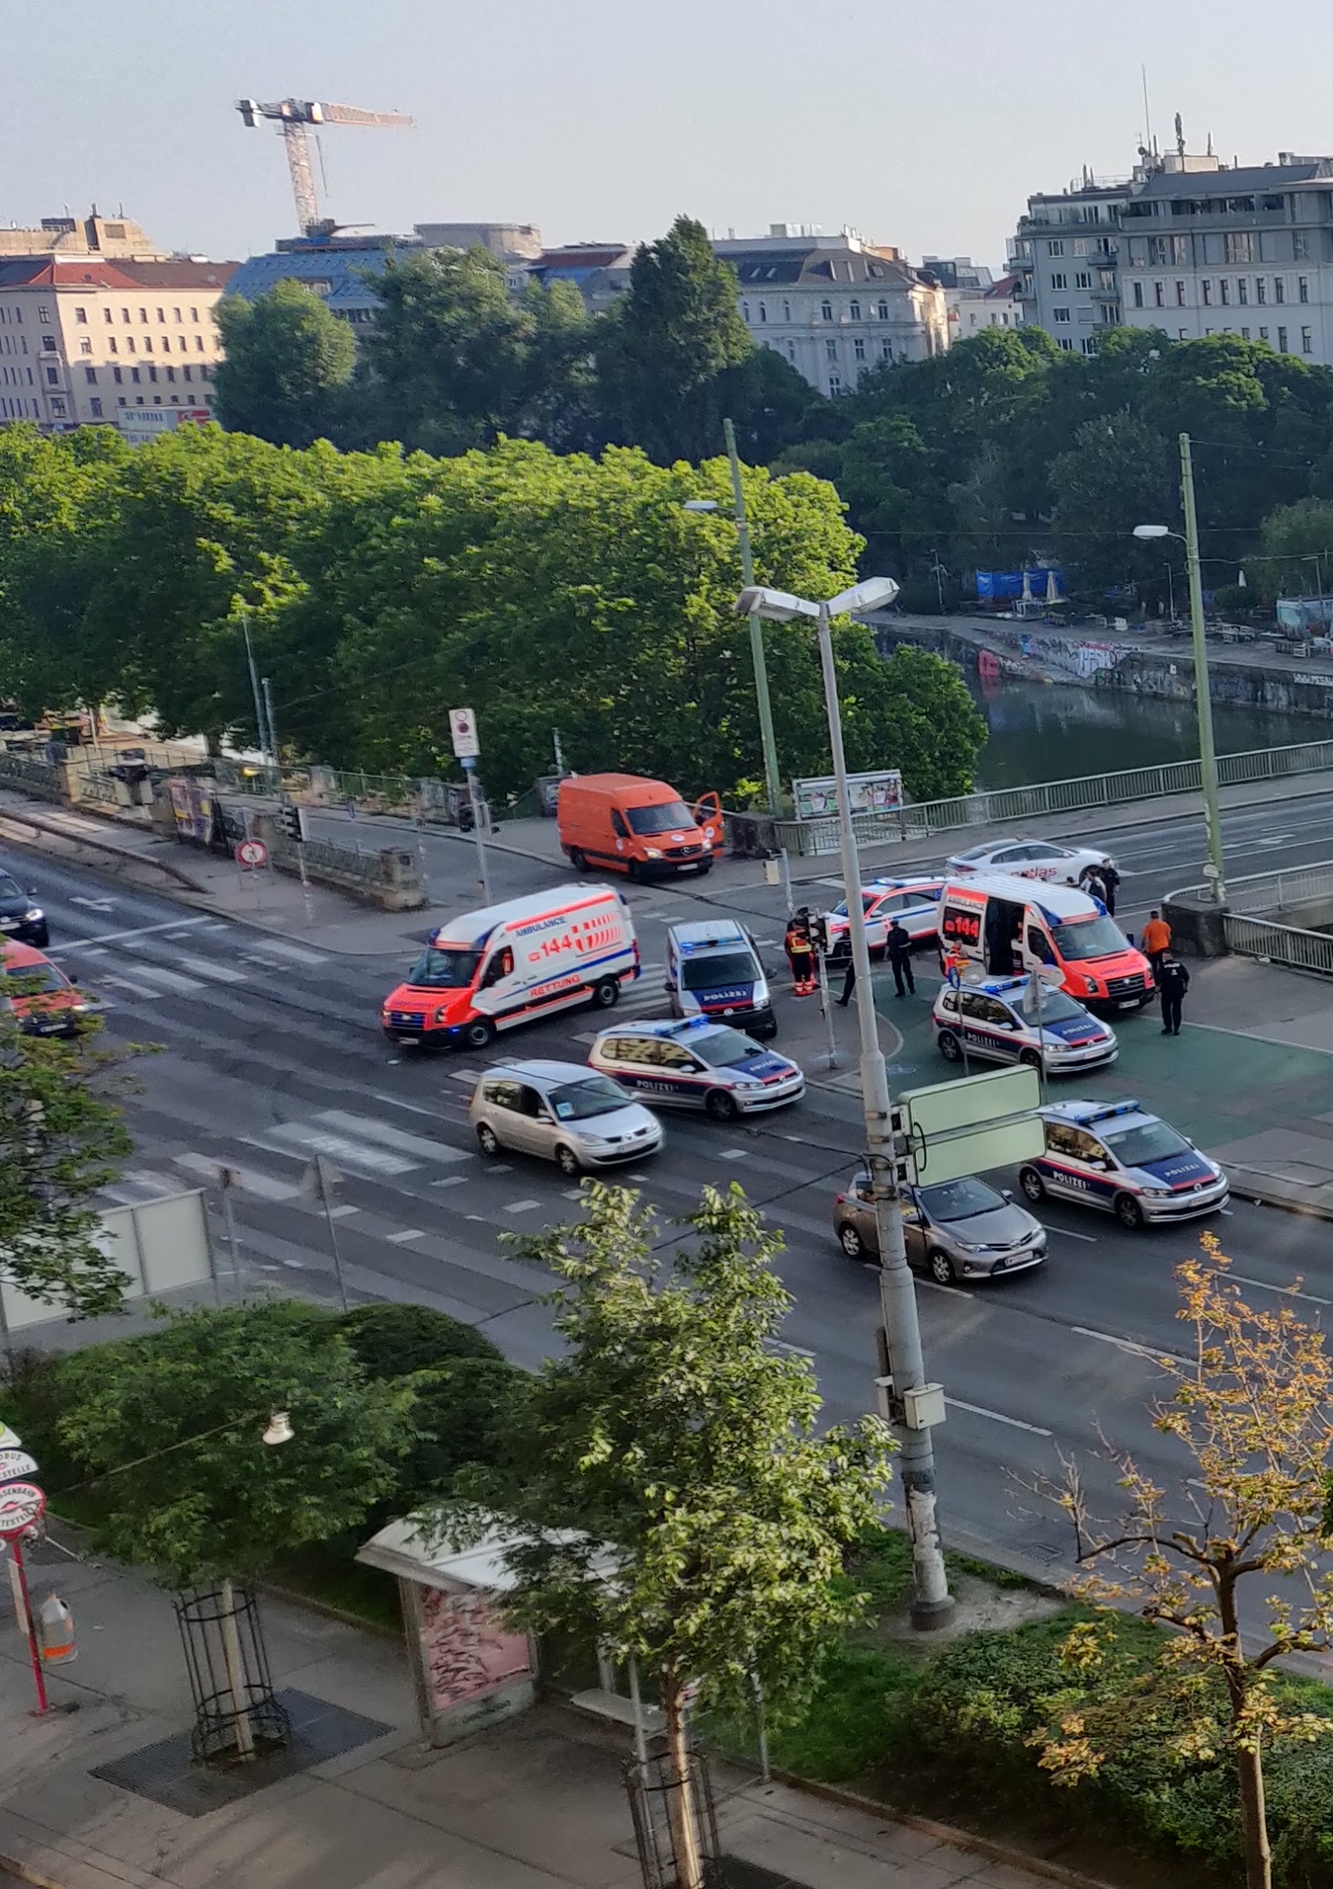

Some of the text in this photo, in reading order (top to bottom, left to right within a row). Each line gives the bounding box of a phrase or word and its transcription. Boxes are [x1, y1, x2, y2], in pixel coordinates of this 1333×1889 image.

[515, 916, 567, 938] AMBULANCE
[955, 917, 979, 938] 144
[540, 934, 572, 957] 144
[529, 974, 580, 998] RETTUNG
[703, 990, 747, 1001] POLIZEI
[967, 1031, 996, 1048] POLIZEI
[636, 1079, 674, 1093] POLIZEI
[1164, 1163, 1200, 1178] POLIZEI
[1053, 1171, 1087, 1190] POLIZEI
